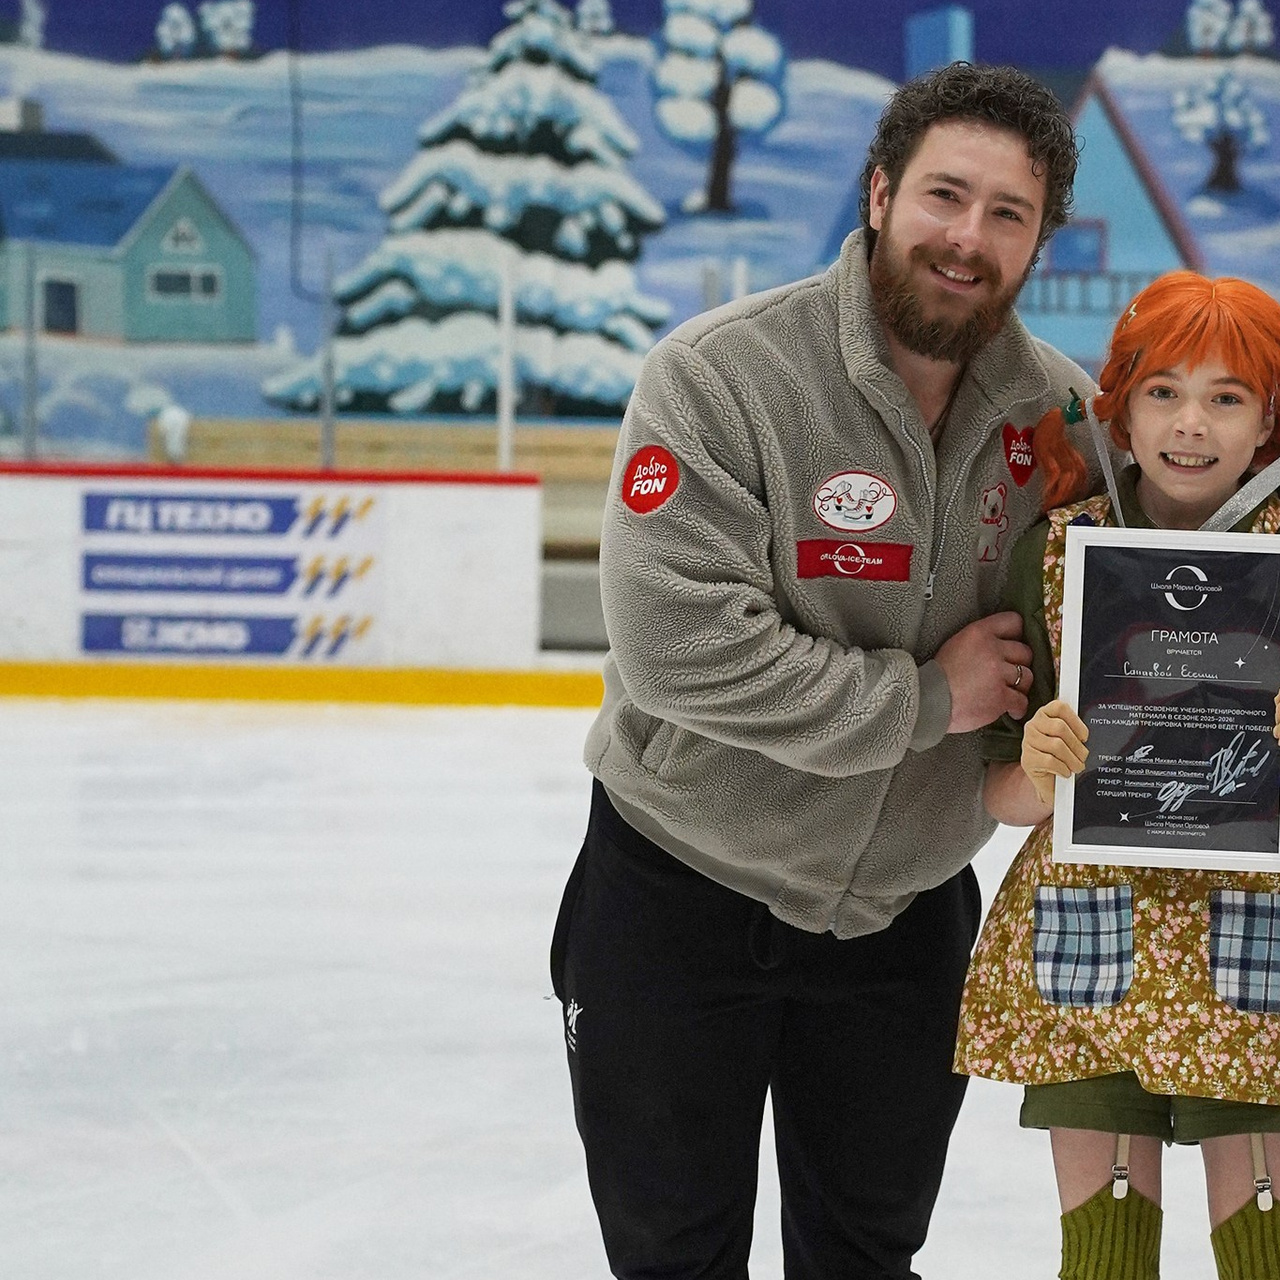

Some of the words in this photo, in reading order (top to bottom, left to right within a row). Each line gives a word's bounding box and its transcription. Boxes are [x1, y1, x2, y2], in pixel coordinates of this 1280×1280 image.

[1009, 452, 1032, 466] FON
[633, 456, 667, 481] Добро
[630, 477, 667, 497] FON
[1150, 582, 1172, 591] Школа
[1172, 583, 1194, 592] Марии
[1194, 584, 1223, 593] Орловой
[1151, 629, 1219, 644] ГРАМОТА
[1166, 648, 1202, 656] ВРУЧАЕТСЯ
[1108, 703, 1143, 712] УСПЕШНОЕ
[1143, 705, 1179, 713] ОСВОЕНИЕ
[1180, 707, 1267, 717] УЧЕБНО-ТРЕНИРОВОЧНОГО
[1129, 712, 1166, 720] МАТЕРИАЛА
[1173, 714, 1199, 722] СЕЗОНЕ
[1140, 720, 1181, 728] ТРЕНИРОВКА
[1183, 722, 1217, 730] УВЕРЕННО
[1098, 754, 1123, 762] ТРЕНЕР:
[1097, 766, 1123, 774] ТРЕНЕР:
[1096, 778, 1122, 786] ТРЕНЕР:
[1128, 791, 1153, 799] ТРЕНЕР:
[1165, 821, 1184, 829] Марии
[1184, 822, 1210, 830] Орловой
